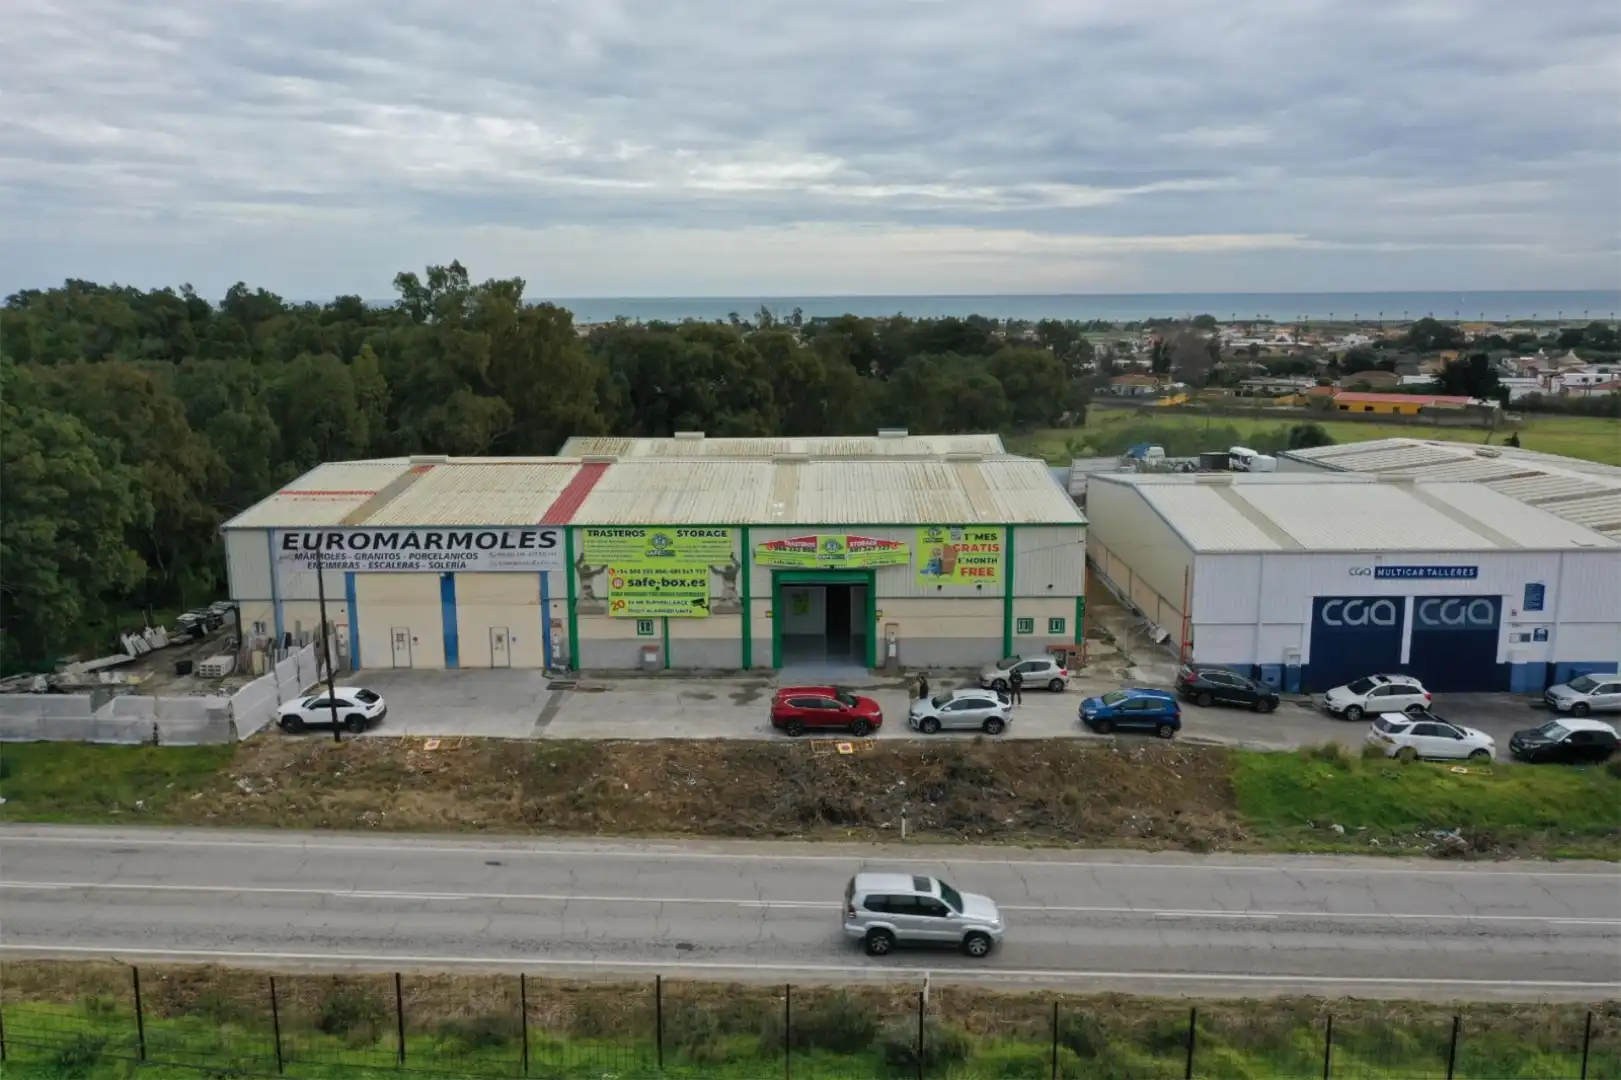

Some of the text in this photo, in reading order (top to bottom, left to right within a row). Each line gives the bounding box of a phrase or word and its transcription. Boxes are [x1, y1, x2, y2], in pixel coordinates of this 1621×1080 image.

[587, 529, 646, 538] TRASTEROS
[676, 529, 728, 538] STORAGE
[974, 533, 998, 541] MES
[952, 543, 1000, 553] GRATIS
[368, 561, 420, 570] ESCALERAS
[965, 557, 998, 565] MONTH
[960, 567, 995, 577] FREE
[1377, 568, 1424, 577] MULTICAR
[1427, 568, 1475, 577] TALLERES
[627, 576, 706, 588] safe-box.es
